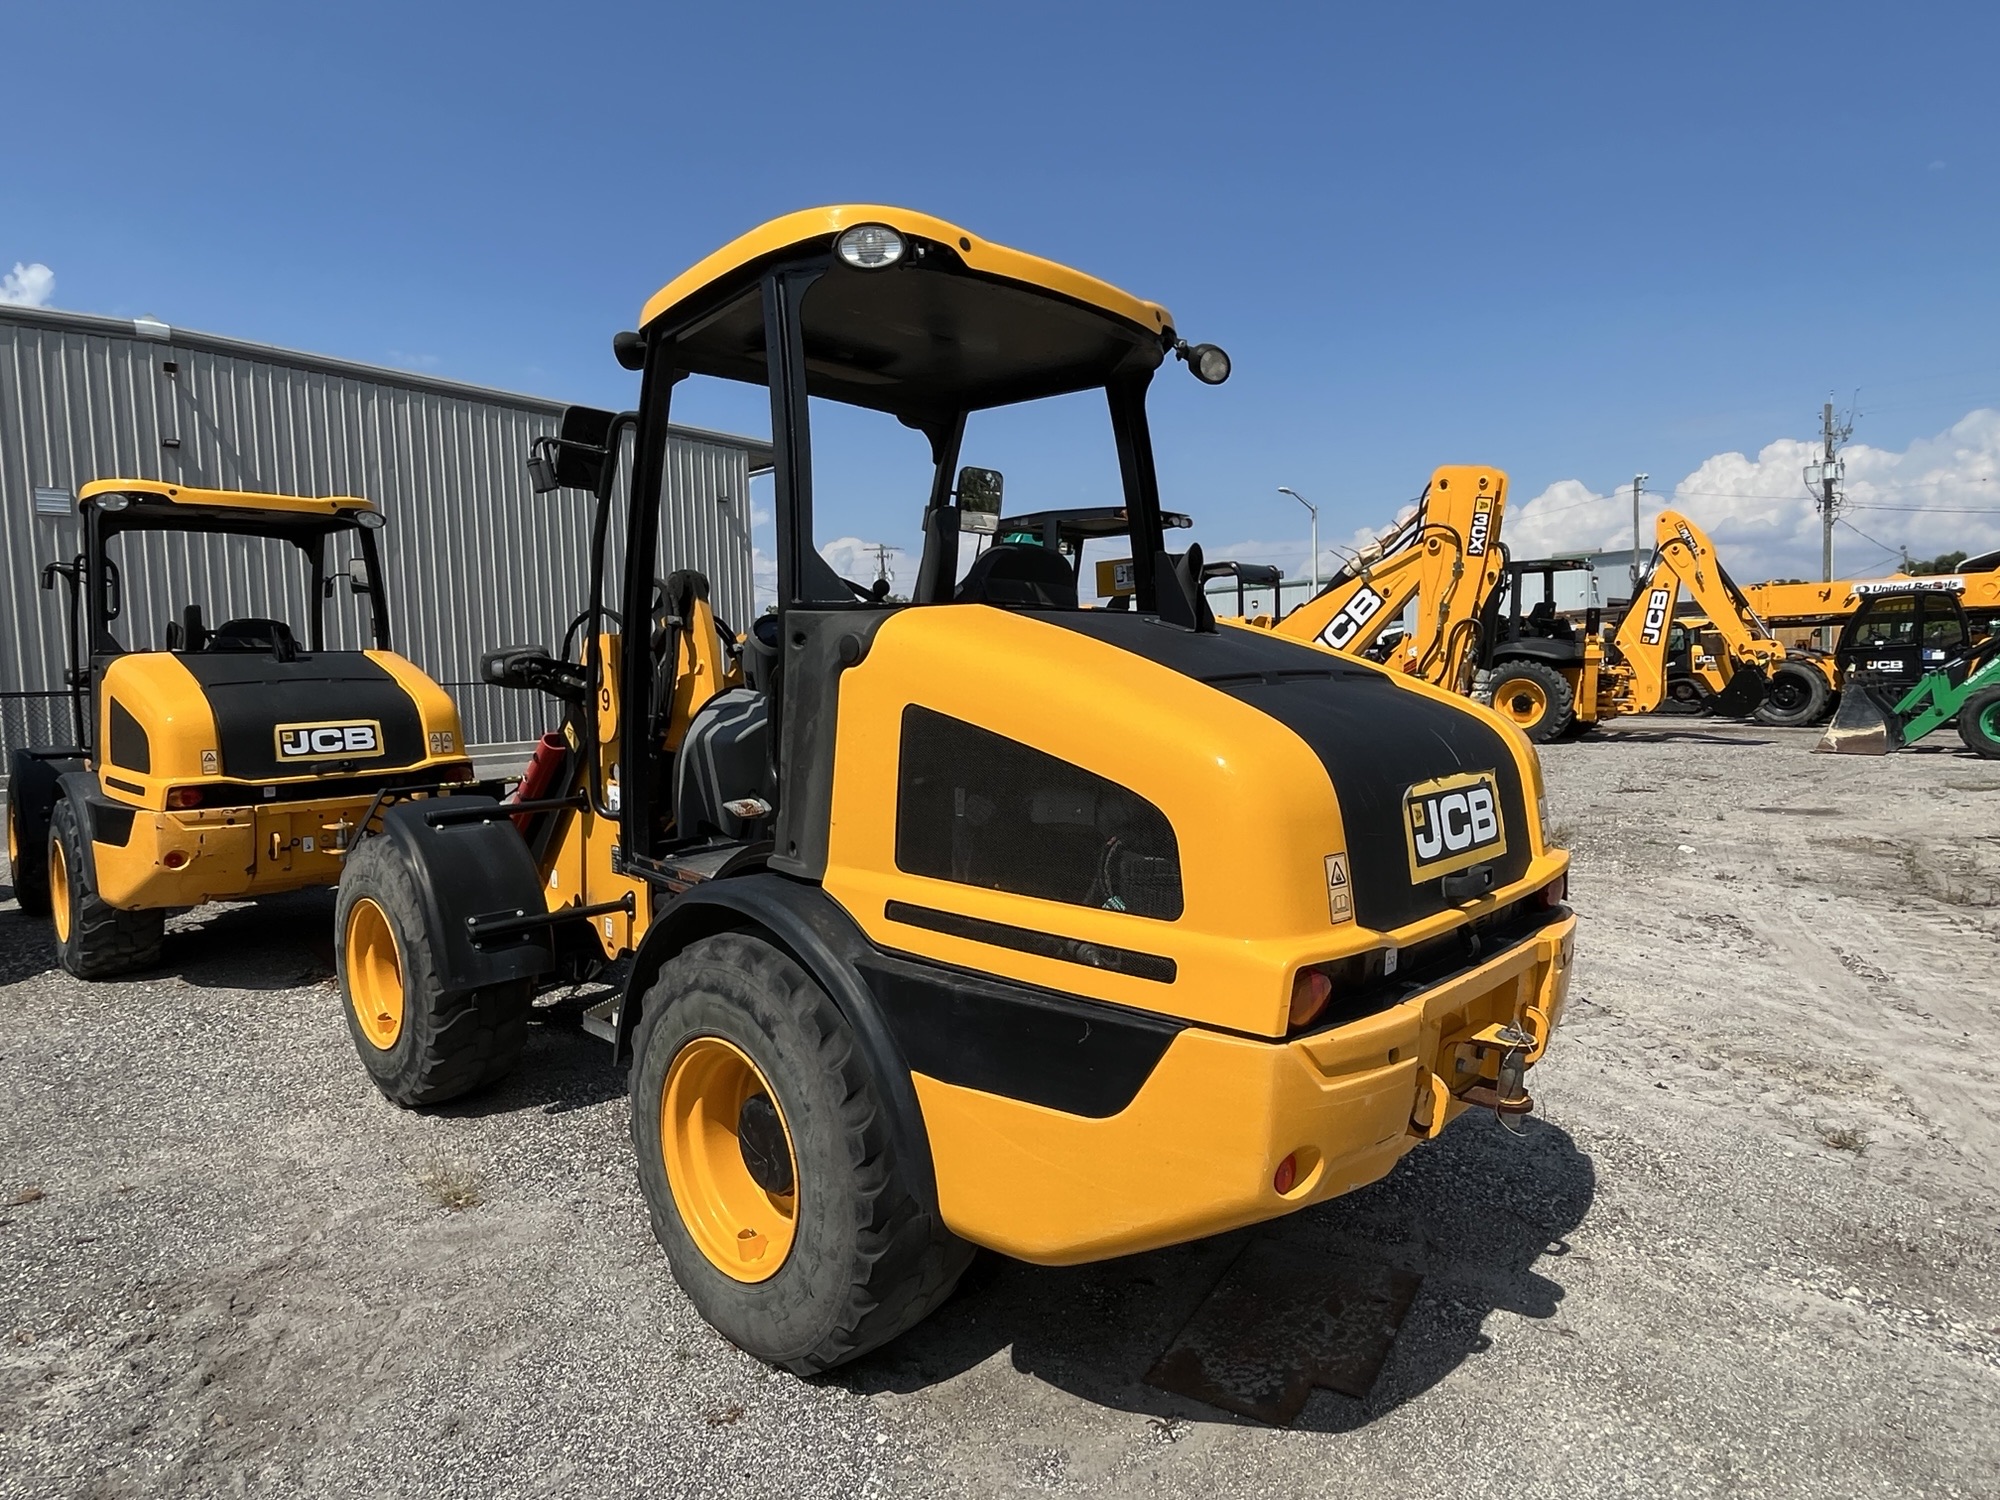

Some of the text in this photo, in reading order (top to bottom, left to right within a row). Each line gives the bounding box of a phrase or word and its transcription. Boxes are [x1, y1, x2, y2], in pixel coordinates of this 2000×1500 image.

[1469, 513, 1489, 550] 3CX
[1872, 584, 1911, 593] United
[1314, 588, 1381, 649] CB
[1643, 590, 1668, 644] JCB
[1867, 660, 1904, 670] JCB
[283, 727, 376, 755] JCB
[1415, 788, 1498, 859] JCB
